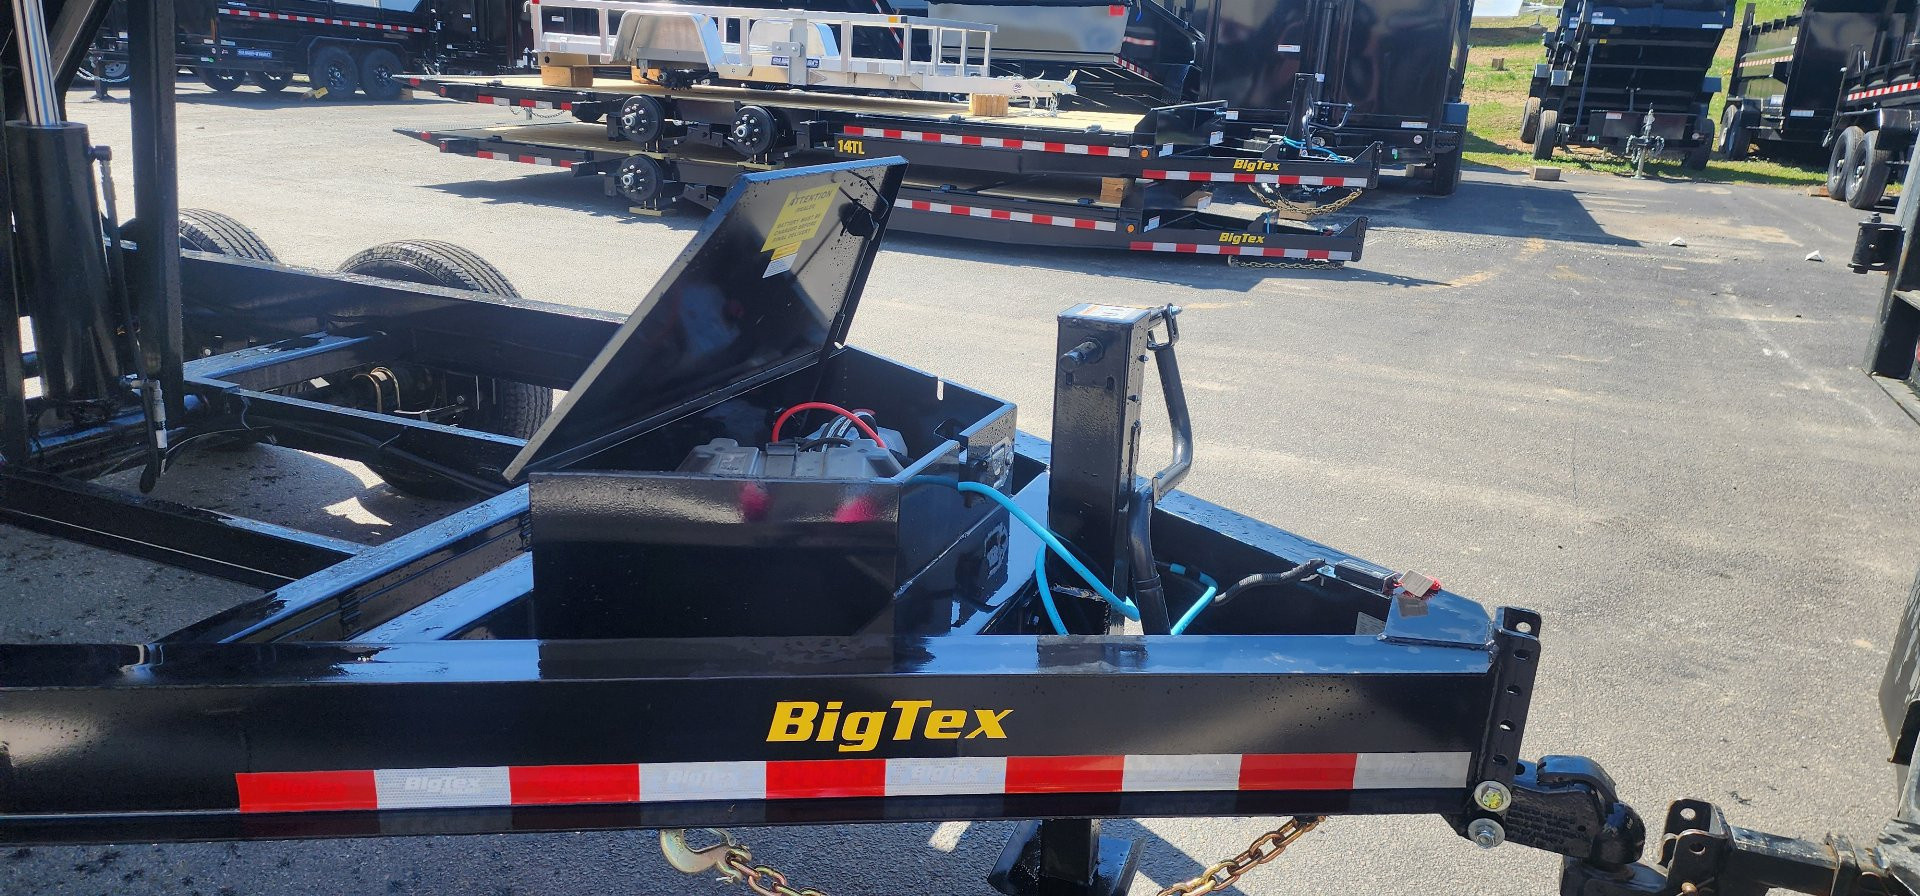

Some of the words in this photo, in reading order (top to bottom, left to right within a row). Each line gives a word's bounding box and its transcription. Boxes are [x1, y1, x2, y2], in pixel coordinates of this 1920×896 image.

[838, 140, 865, 154] 14TL
[1233, 159, 1280, 172] BigTex
[788, 191, 832, 206] ATTENTION
[1218, 232, 1265, 245] BigTex
[766, 700, 1014, 752] BigTex
[404, 776, 481, 791] BigTex
